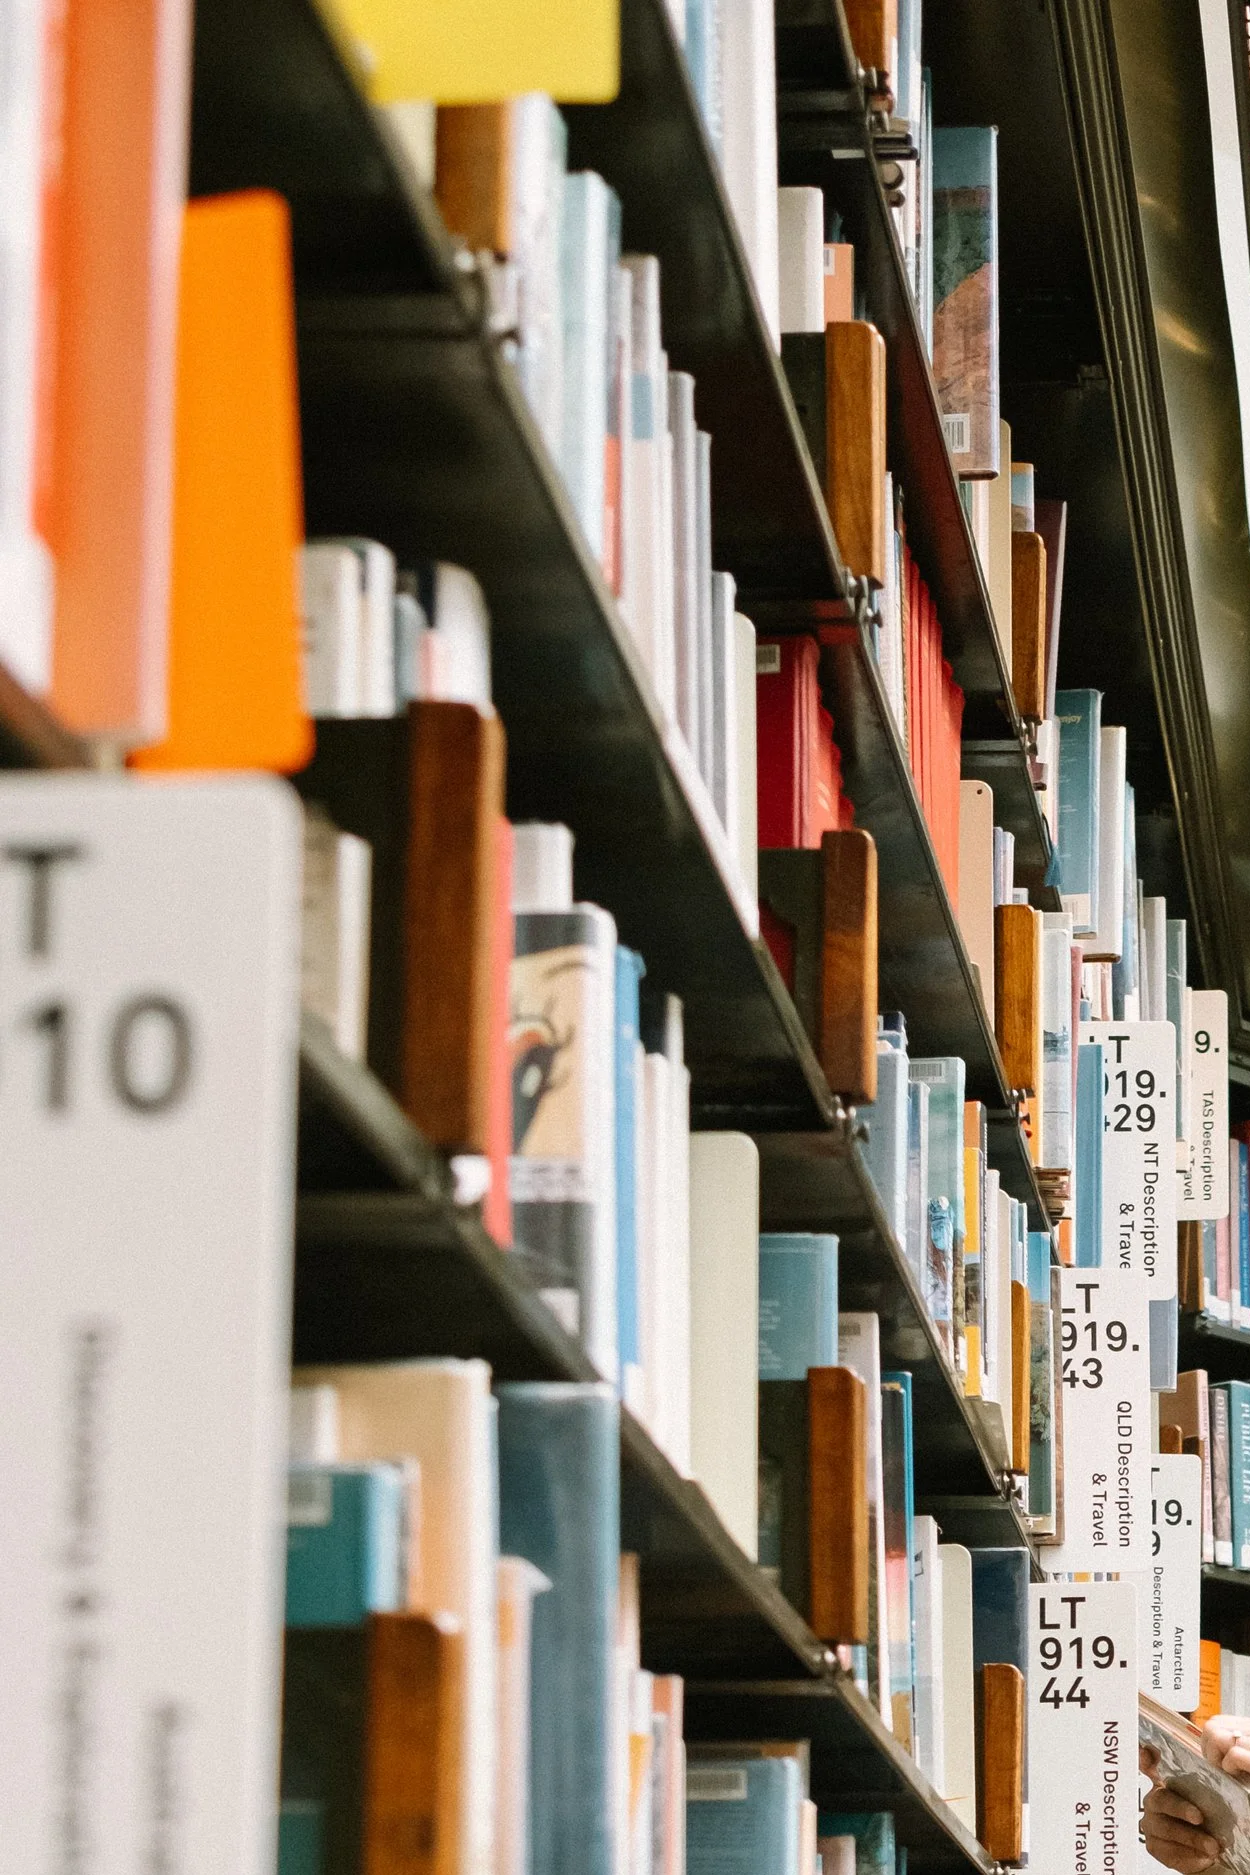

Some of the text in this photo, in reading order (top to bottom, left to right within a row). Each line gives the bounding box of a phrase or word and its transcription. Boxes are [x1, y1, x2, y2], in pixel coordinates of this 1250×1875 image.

[1195, 1031, 1219, 1053] 9.
[1104, 1104, 1155, 1132] 29
[1201, 1091, 1214, 1200] TAS Description
[1140, 1143, 1158, 1277] NT Description
[1120, 1203, 1134, 1268] & Trave
[1063, 1321, 1139, 1352] 919.
[1115, 1401, 1133, 1546] QLD Description
[1092, 1473, 1107, 1547] & Travel
[1152, 1500, 1192, 1525] 19.
[1040, 1597, 1085, 1629] LT
[1151, 1567, 1163, 1636] Description
[1040, 1636, 1127, 1670] 919.
[1153, 1640, 1162, 1648] &
[1174, 1627, 1184, 1690] Antarctica
[1153, 1653, 1162, 1689] Travel
[1040, 1676, 1090, 1709] 44
[1104, 1722, 1118, 1765] NSW
[1076, 1803, 1090, 1815] &
